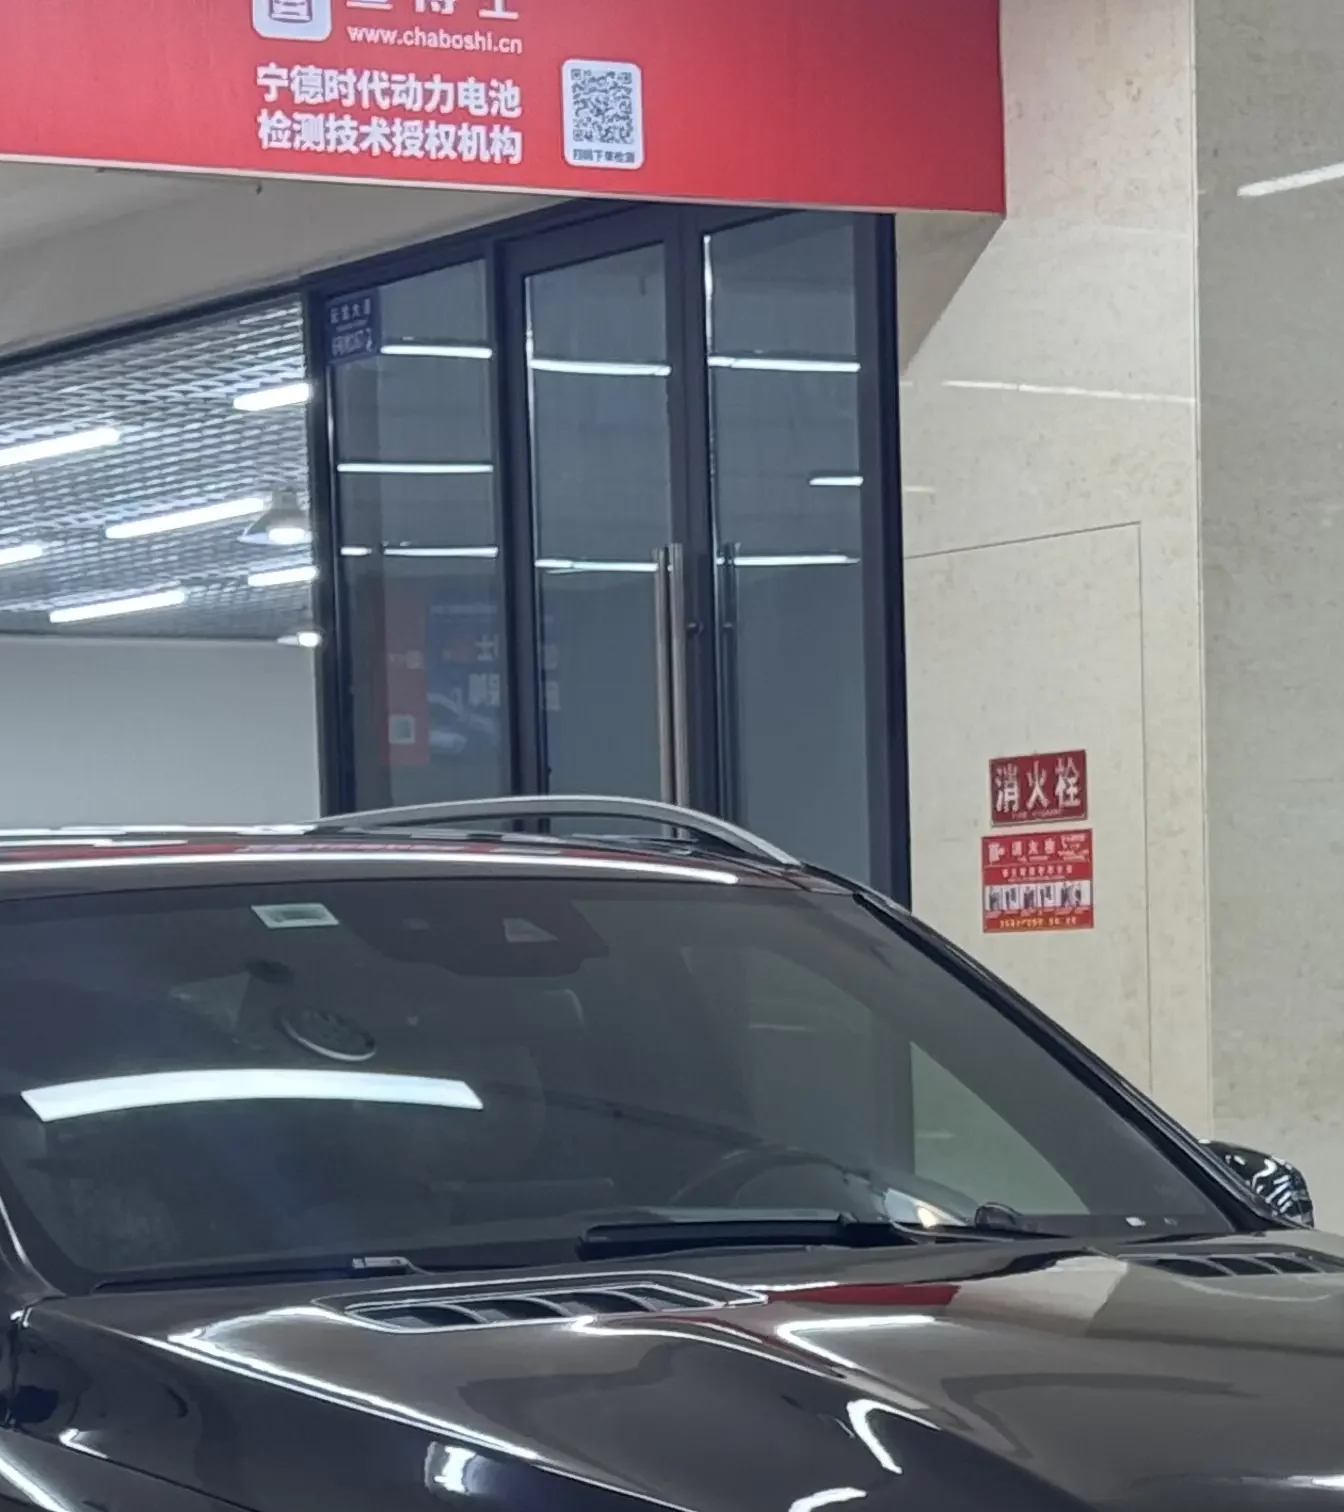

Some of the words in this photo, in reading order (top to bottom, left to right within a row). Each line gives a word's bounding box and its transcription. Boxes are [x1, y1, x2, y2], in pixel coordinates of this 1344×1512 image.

[346, 25, 523, 54] www.chaboshi.cn
[256, 62, 523, 118] 宁德时代动力电池
[257, 108, 523, 165] 检测技术授权机构
[995, 757, 1081, 813] 消火栓
